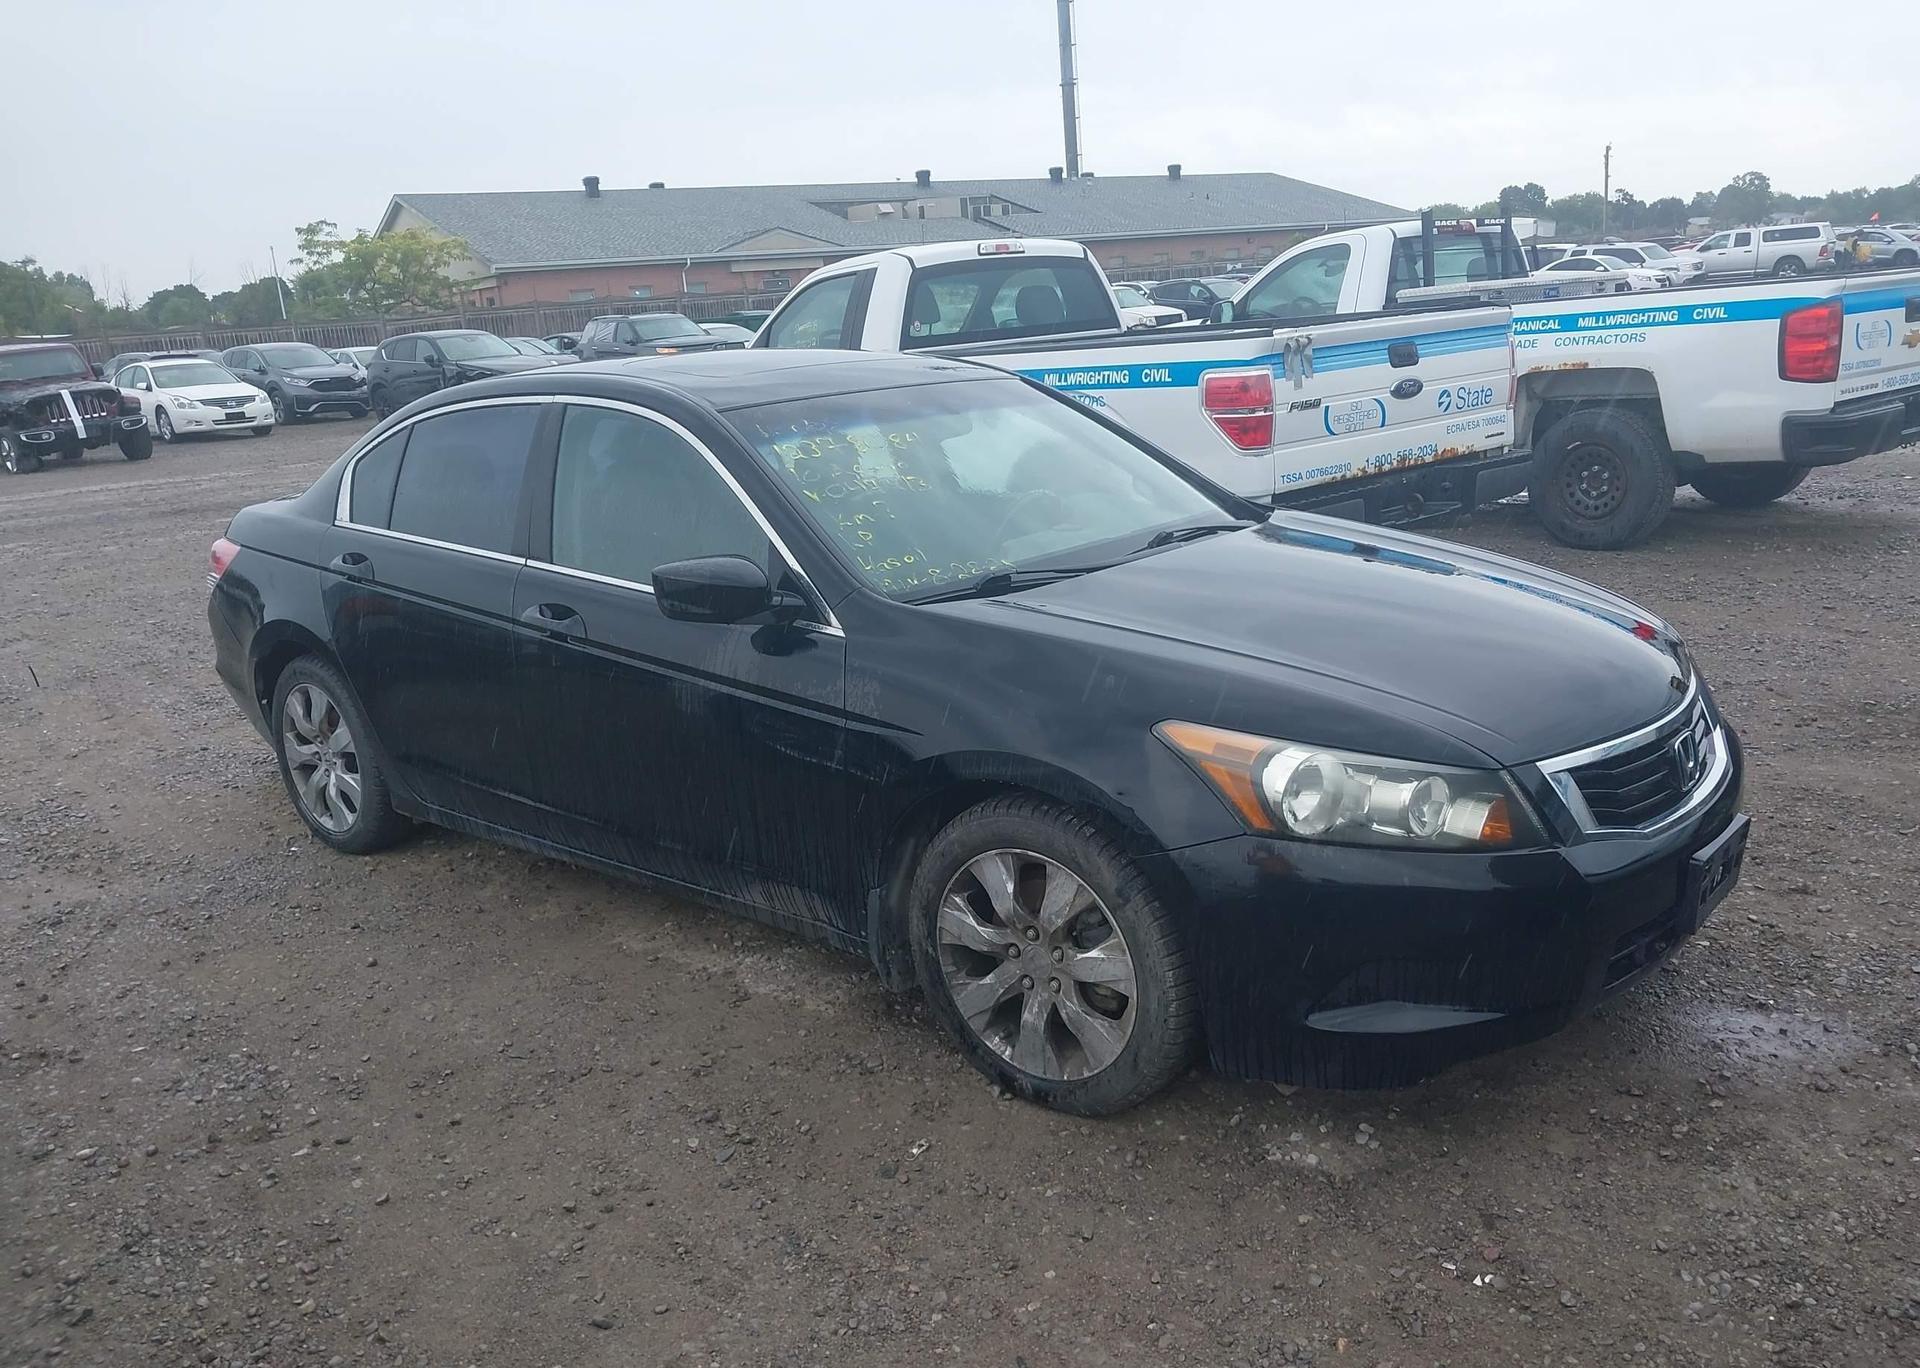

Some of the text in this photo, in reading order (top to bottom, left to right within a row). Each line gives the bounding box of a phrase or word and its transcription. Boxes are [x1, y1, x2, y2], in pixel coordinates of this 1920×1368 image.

[1512, 306, 1728, 331] HANICAL MILLWRIGHTING CIVIL
[1515, 332, 1647, 349] ADE CONTRACTORS
[1043, 368, 1172, 386] MILLWRIGHTING CIVIL
[1072, 395, 1106, 408] TORS
[1456, 385, 1493, 410] State
[1446, 420, 1480, 435] ECRA/ESA
[1365, 443, 1438, 470] 1-800-558-2034
[1281, 462, 1352, 485] TSSA 0076622810
